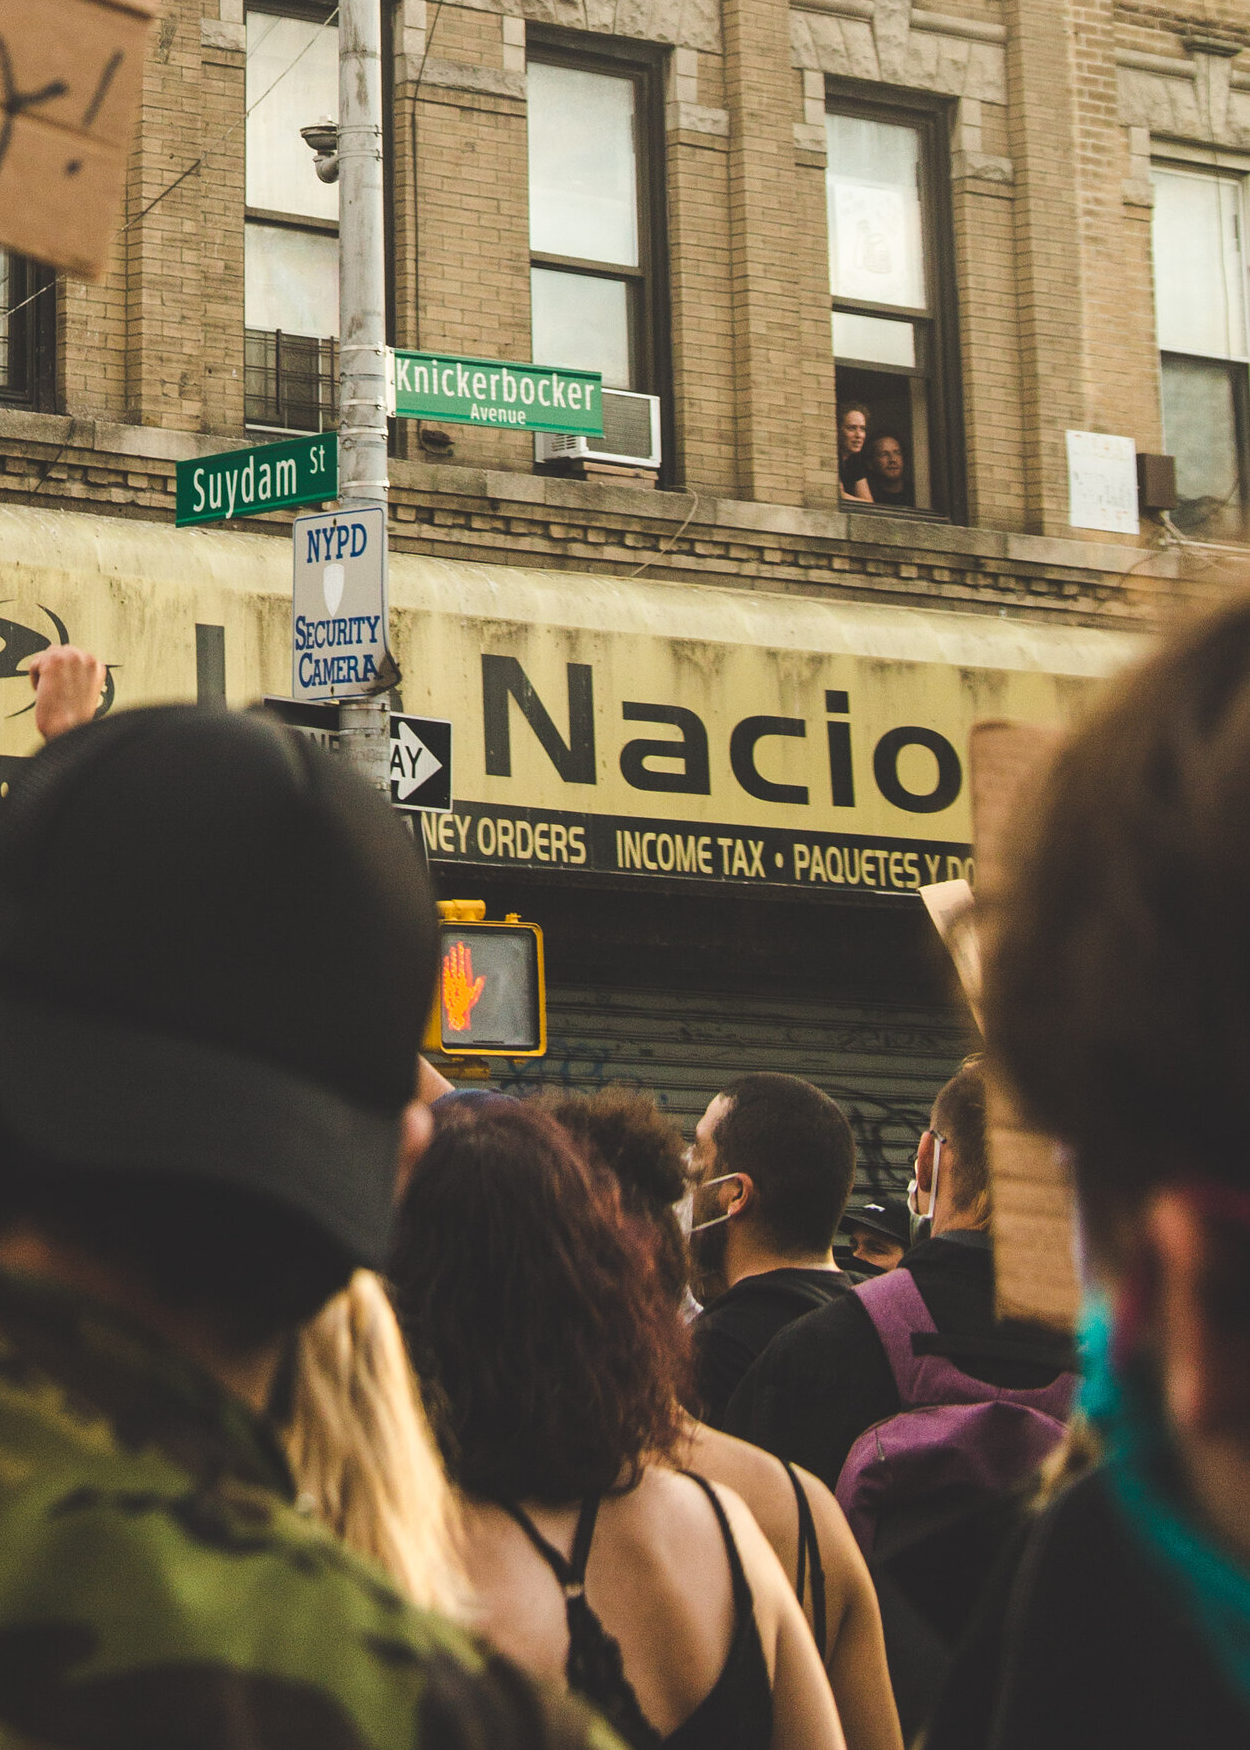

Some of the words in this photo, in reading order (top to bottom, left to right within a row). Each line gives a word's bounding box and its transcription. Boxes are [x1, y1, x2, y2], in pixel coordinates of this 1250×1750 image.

[396, 358, 595, 410] Knickerbocker
[470, 403, 526, 426] Avenue
[193, 455, 297, 519] Suydam
[309, 444, 326, 474] St
[306, 523, 368, 564] NYPD
[295, 615, 380, 651] SECURITY
[298, 652, 379, 689] CAMERA
[481, 653, 962, 814] Nacio
[390, 744, 423, 779] AY
[421, 812, 472, 853] NEY
[477, 817, 586, 865] ORDERS
[616, 829, 713, 875] INCOME
[722, 838, 766, 879] TAX
[792, 843, 922, 889] PAQUETES
[924, 853, 941, 884] Y
[946, 856, 976, 889] DO
